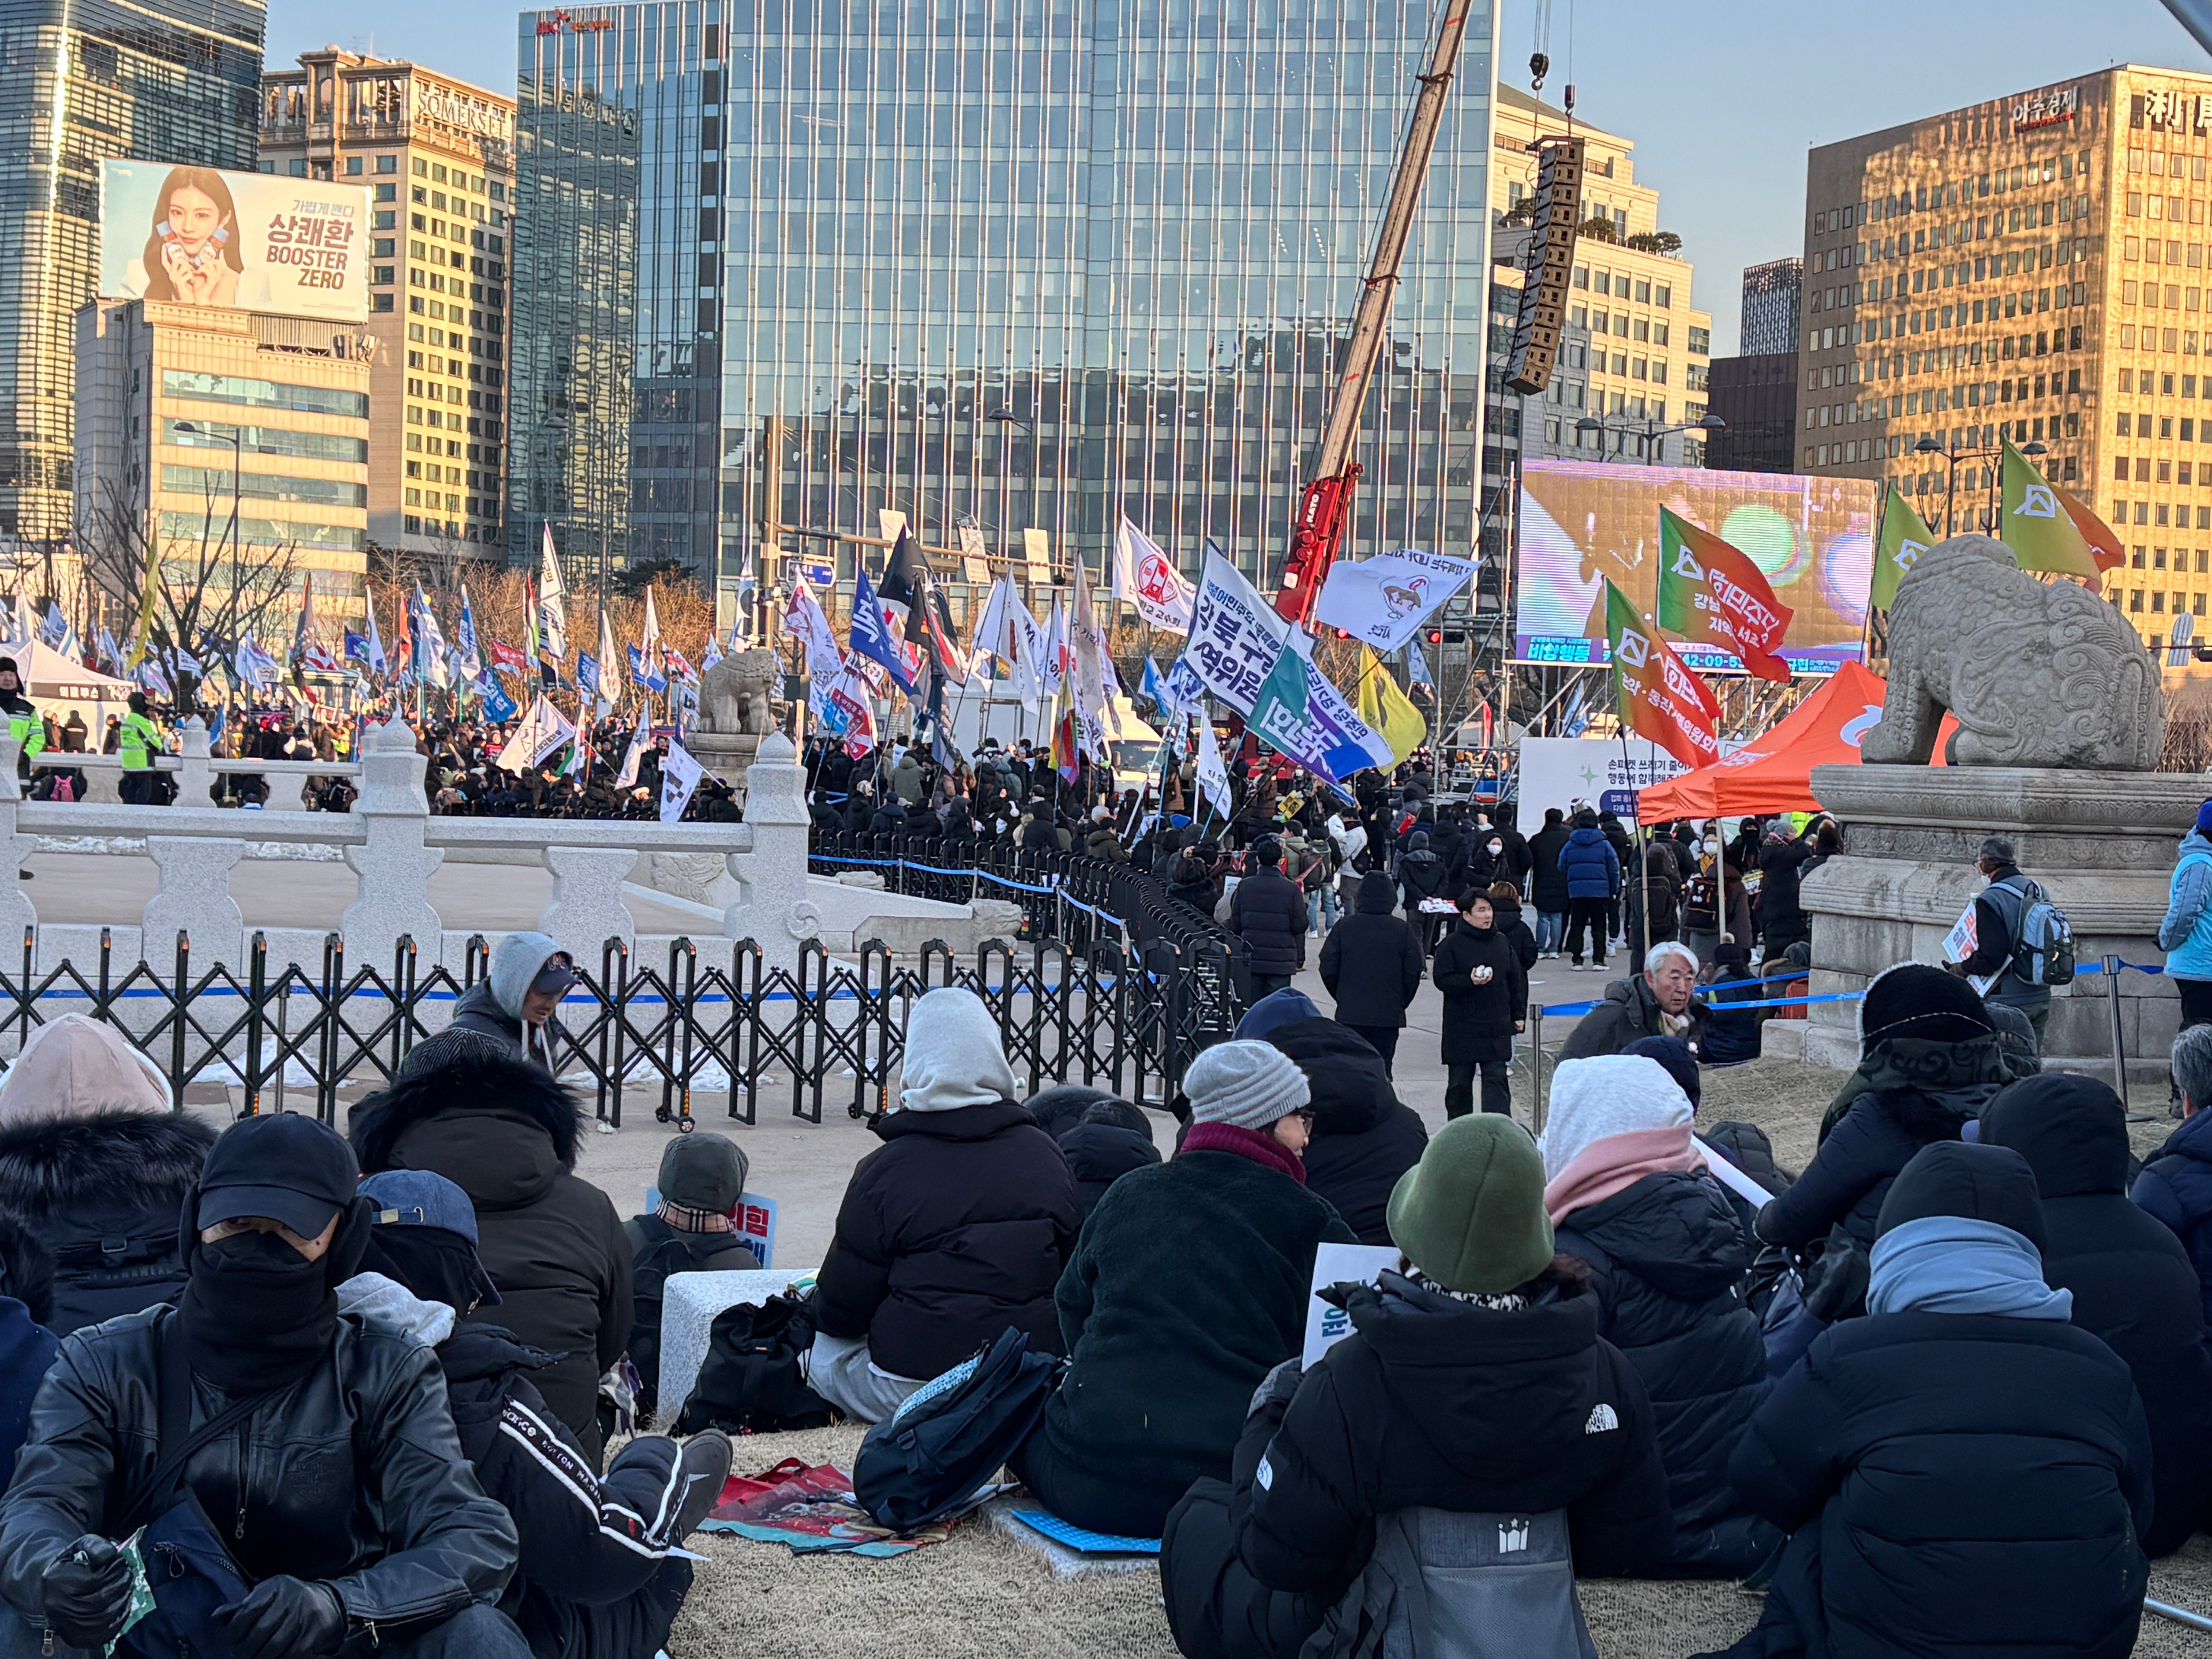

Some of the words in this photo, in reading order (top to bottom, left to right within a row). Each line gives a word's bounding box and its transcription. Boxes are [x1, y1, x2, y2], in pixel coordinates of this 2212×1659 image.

[2013, 86, 2078, 124] 아주경제
[268, 214, 354, 249] 상쾌환
[267, 244, 347, 270] BOOSTER
[298, 268, 344, 290] ZERO
[1307, 493, 1319, 523] KATO
[1709, 568, 1779, 643] 회민주당
[1528, 643, 1591, 662] 비상행동
[1608, 759, 1636, 770] 손피켓
